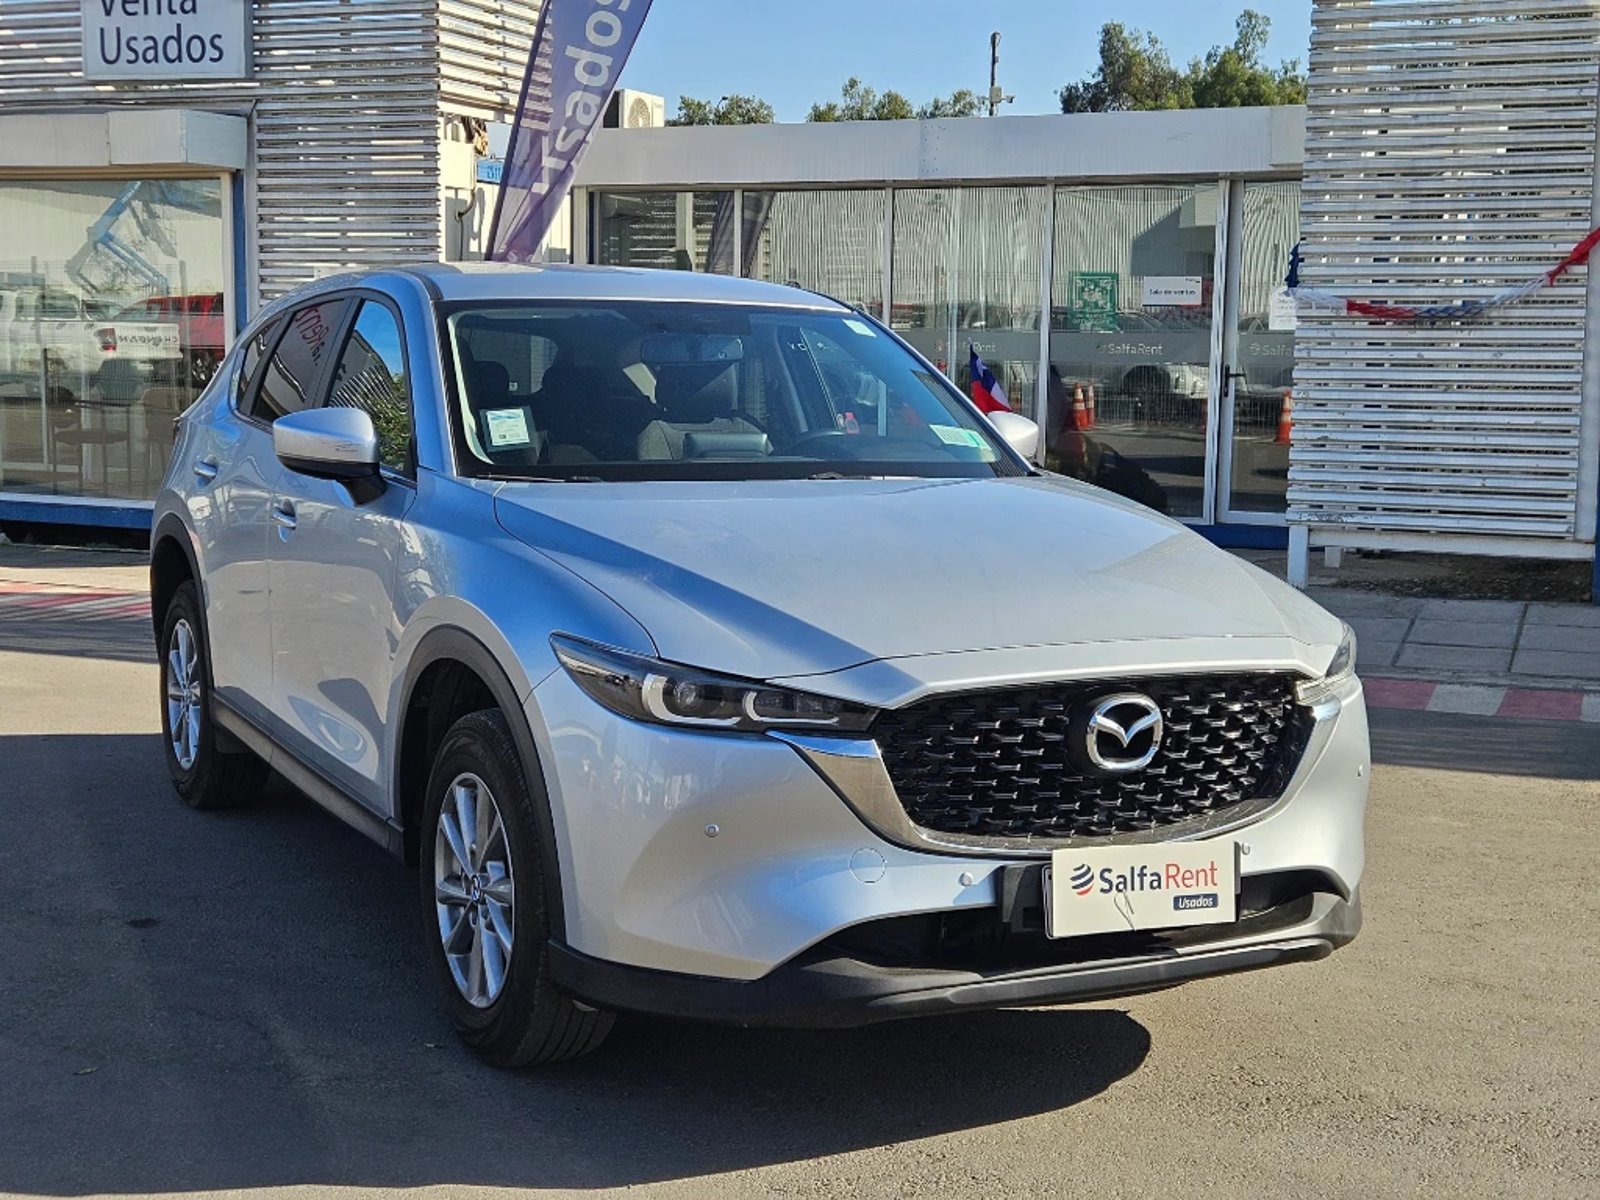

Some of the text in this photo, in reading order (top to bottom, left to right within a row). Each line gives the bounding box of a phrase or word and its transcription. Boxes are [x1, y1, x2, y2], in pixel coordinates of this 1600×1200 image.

[100, 23, 224, 65] Usados
[1099, 860, 1219, 894] SalfaRent
[1178, 895, 1214, 909] Usados
